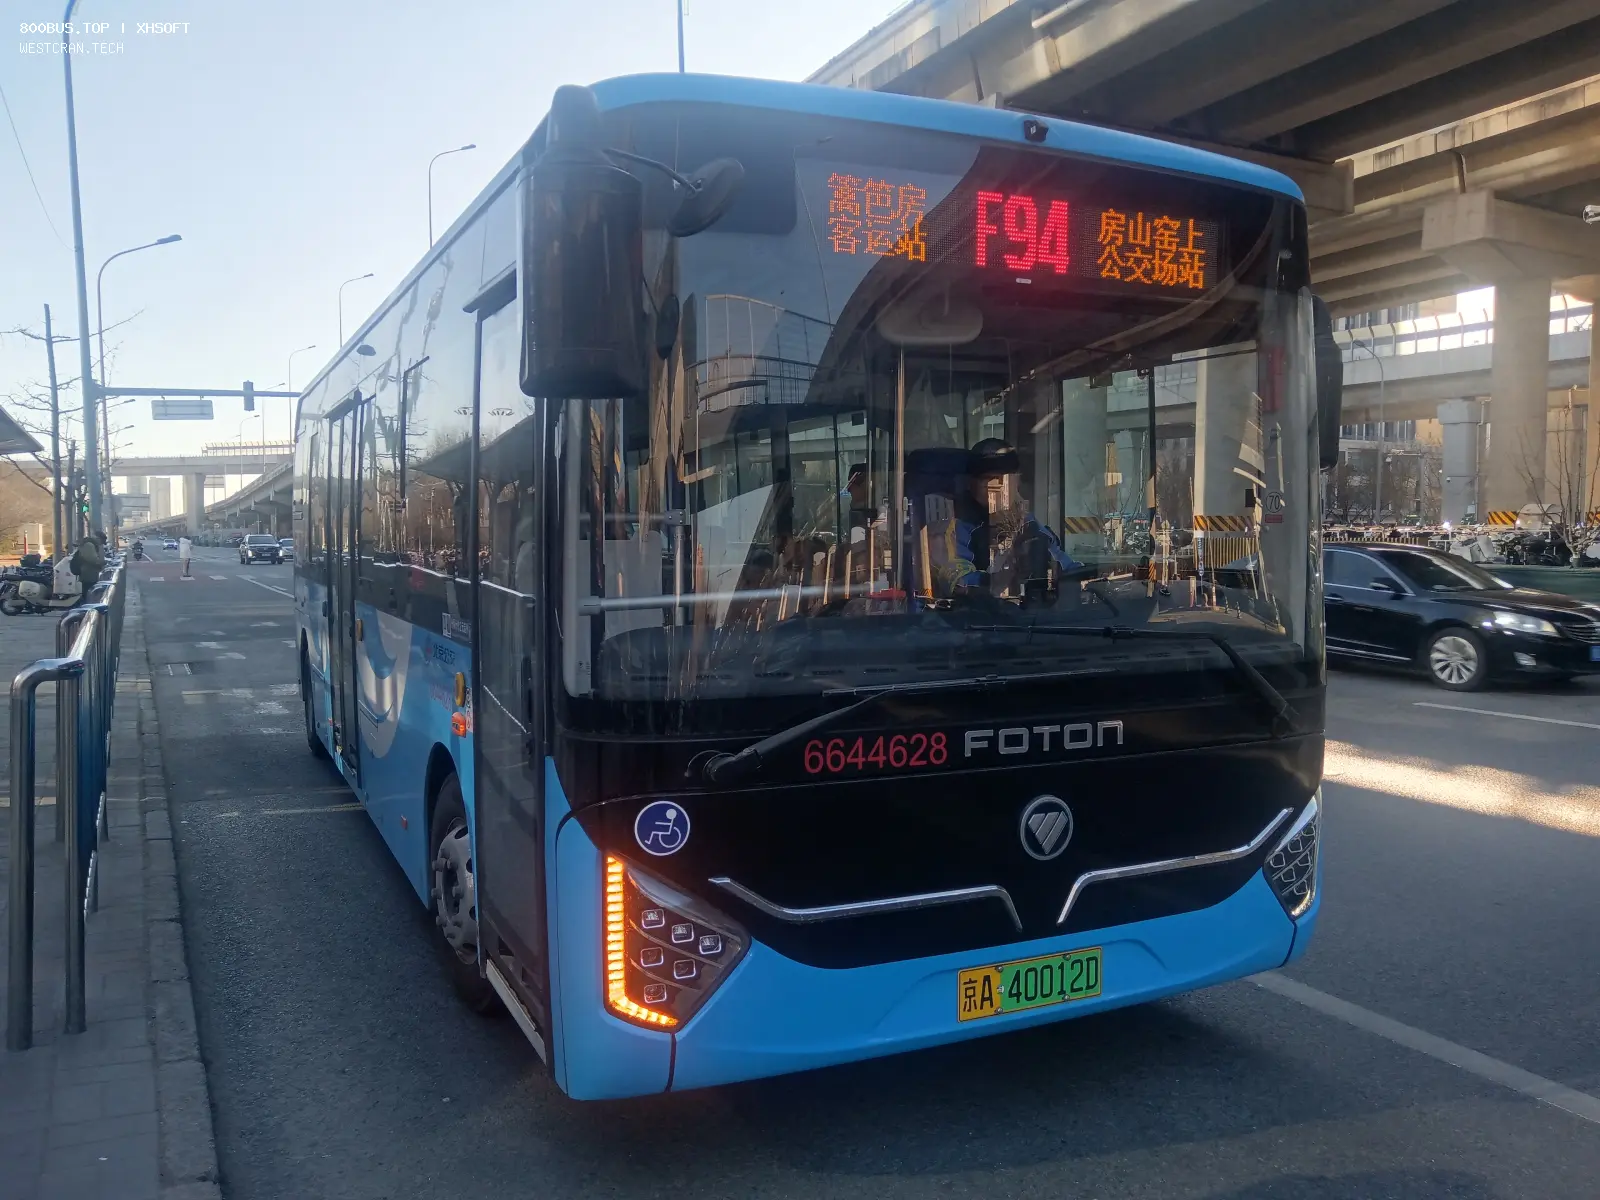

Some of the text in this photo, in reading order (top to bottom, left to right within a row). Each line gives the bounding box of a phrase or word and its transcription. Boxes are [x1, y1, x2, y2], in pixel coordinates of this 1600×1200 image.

[827, 213, 927, 262] 客运站
[976, 190, 1070, 274] F94
[1098, 208, 1206, 254] 房山窑上
[1097, 244, 1205, 289] 公交场站
[803, 732, 948, 774] 6644628
[964, 719, 1124, 757] FOTON
